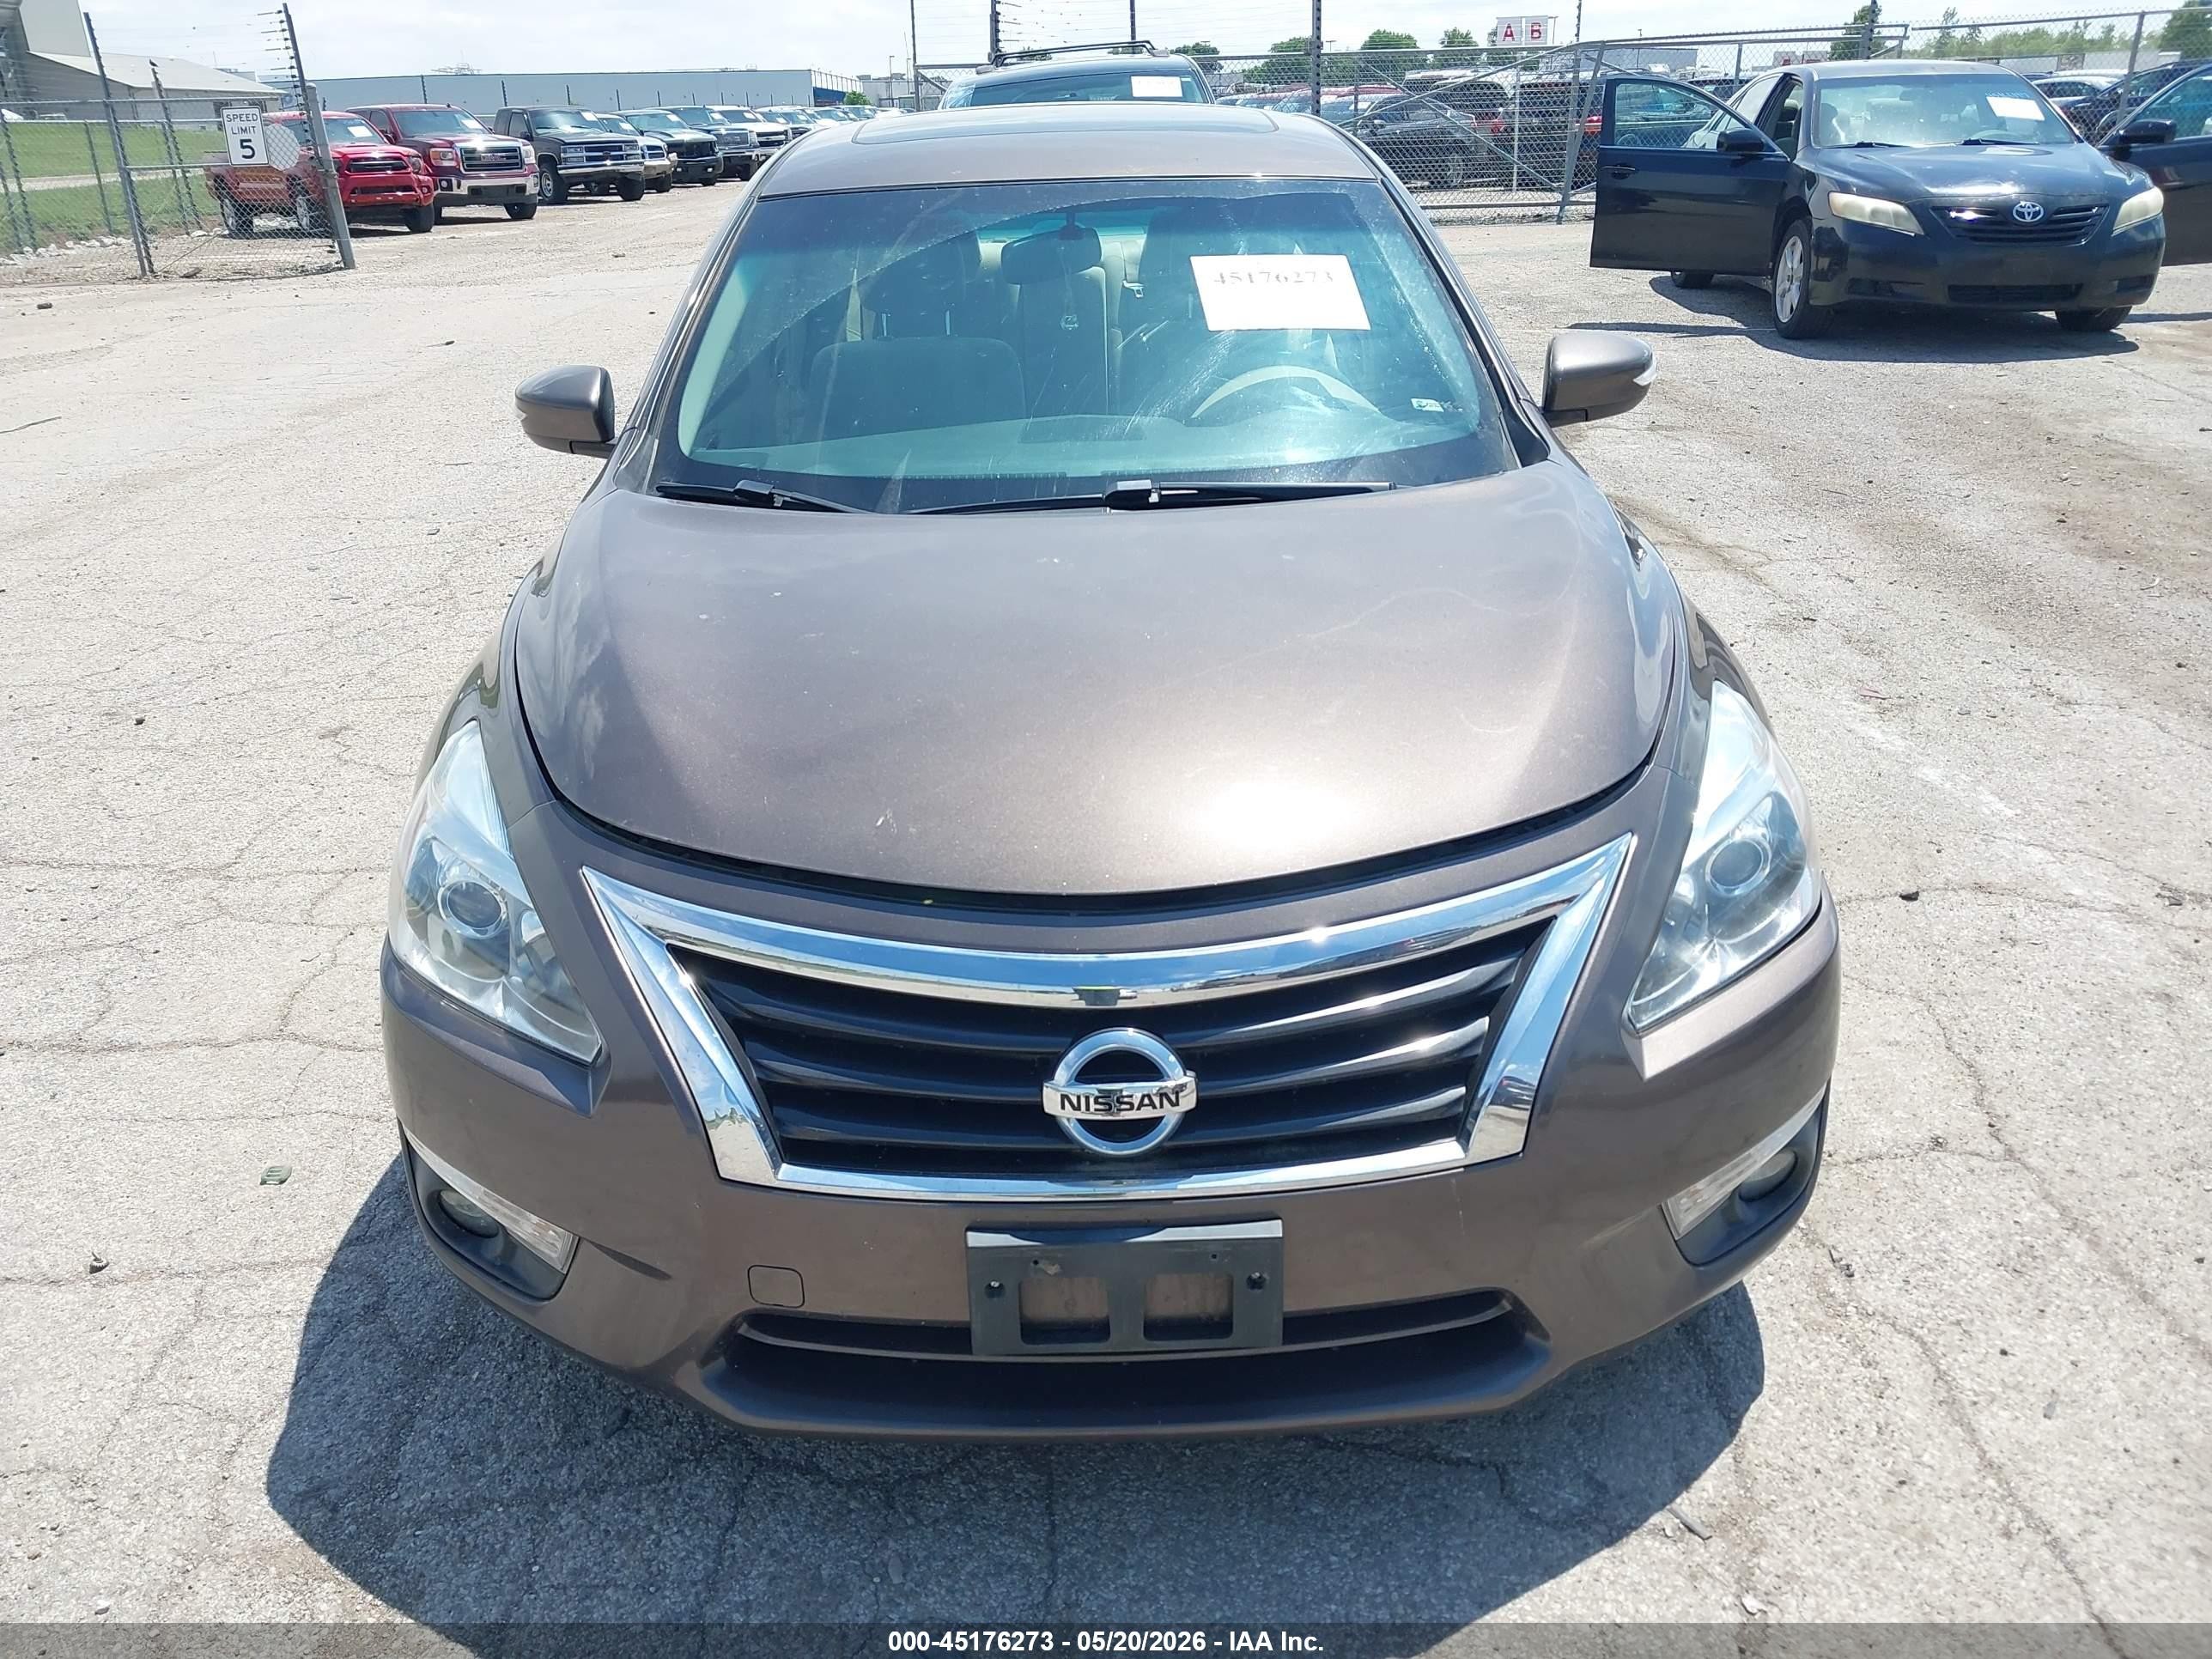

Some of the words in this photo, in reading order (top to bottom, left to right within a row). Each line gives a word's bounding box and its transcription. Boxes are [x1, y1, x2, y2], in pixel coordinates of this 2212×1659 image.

[1502, 23, 1516, 41] A
[1530, 21, 1542, 40] B
[226, 113, 258, 123] SPEED
[231, 125, 257, 135] LIMIT
[240, 138, 256, 160] 5
[1060, 1090, 1181, 1113] NISSAN
